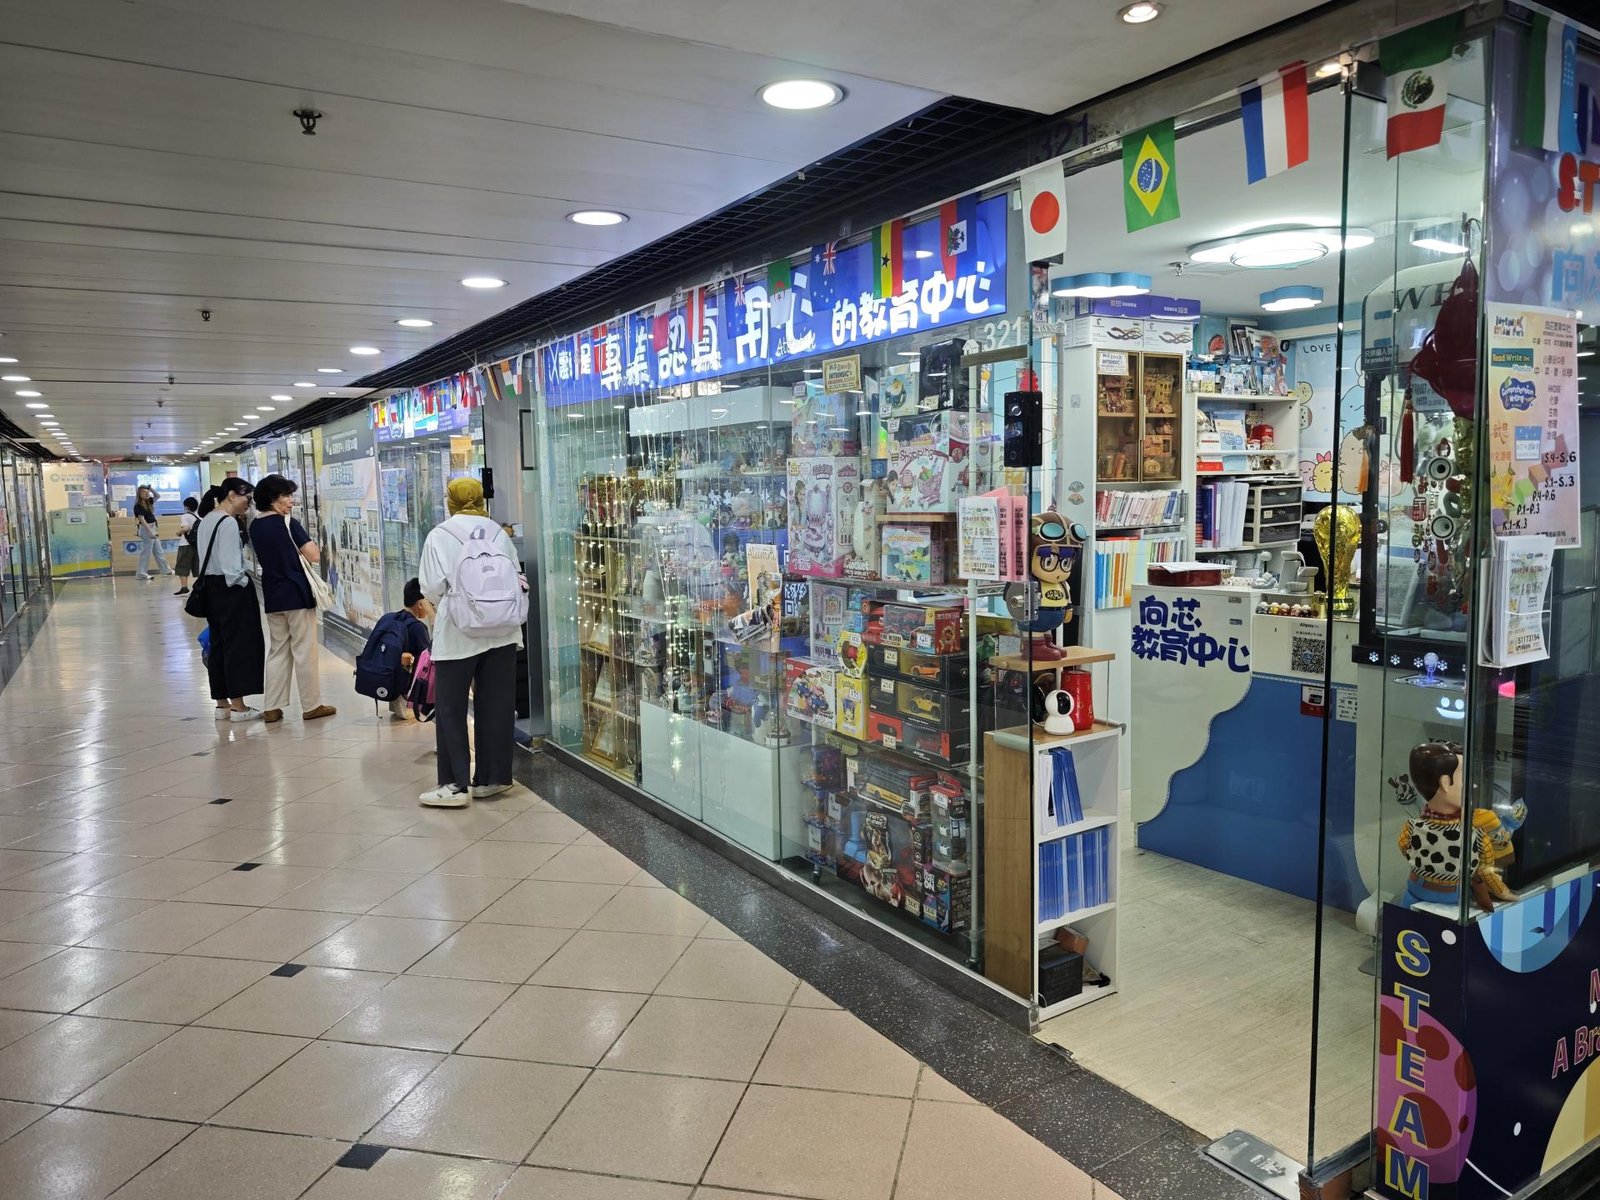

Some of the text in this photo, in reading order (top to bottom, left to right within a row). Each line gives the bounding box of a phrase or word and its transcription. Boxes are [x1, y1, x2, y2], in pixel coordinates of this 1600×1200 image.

[983, 316, 1023, 351] 321
[1492, 352, 1506, 363] Read
[1506, 353, 1522, 363] Write
[899, 447, 934, 461] Shopping
[1544, 451, 1577, 463] S.4-S.6
[1544, 475, 1575, 488] S.1-S.3
[1532, 489, 1556, 502] P.4-P.6
[1516, 502, 1541, 515] P.1-P.3
[1502, 518, 1528, 531] K.1-K.3
[1138, 594, 1202, 631] 向芯
[1131, 625, 1251, 674] 教育中心
[1386, 928, 1432, 1200] STEAM
[1551, 1036, 1569, 1080] A
